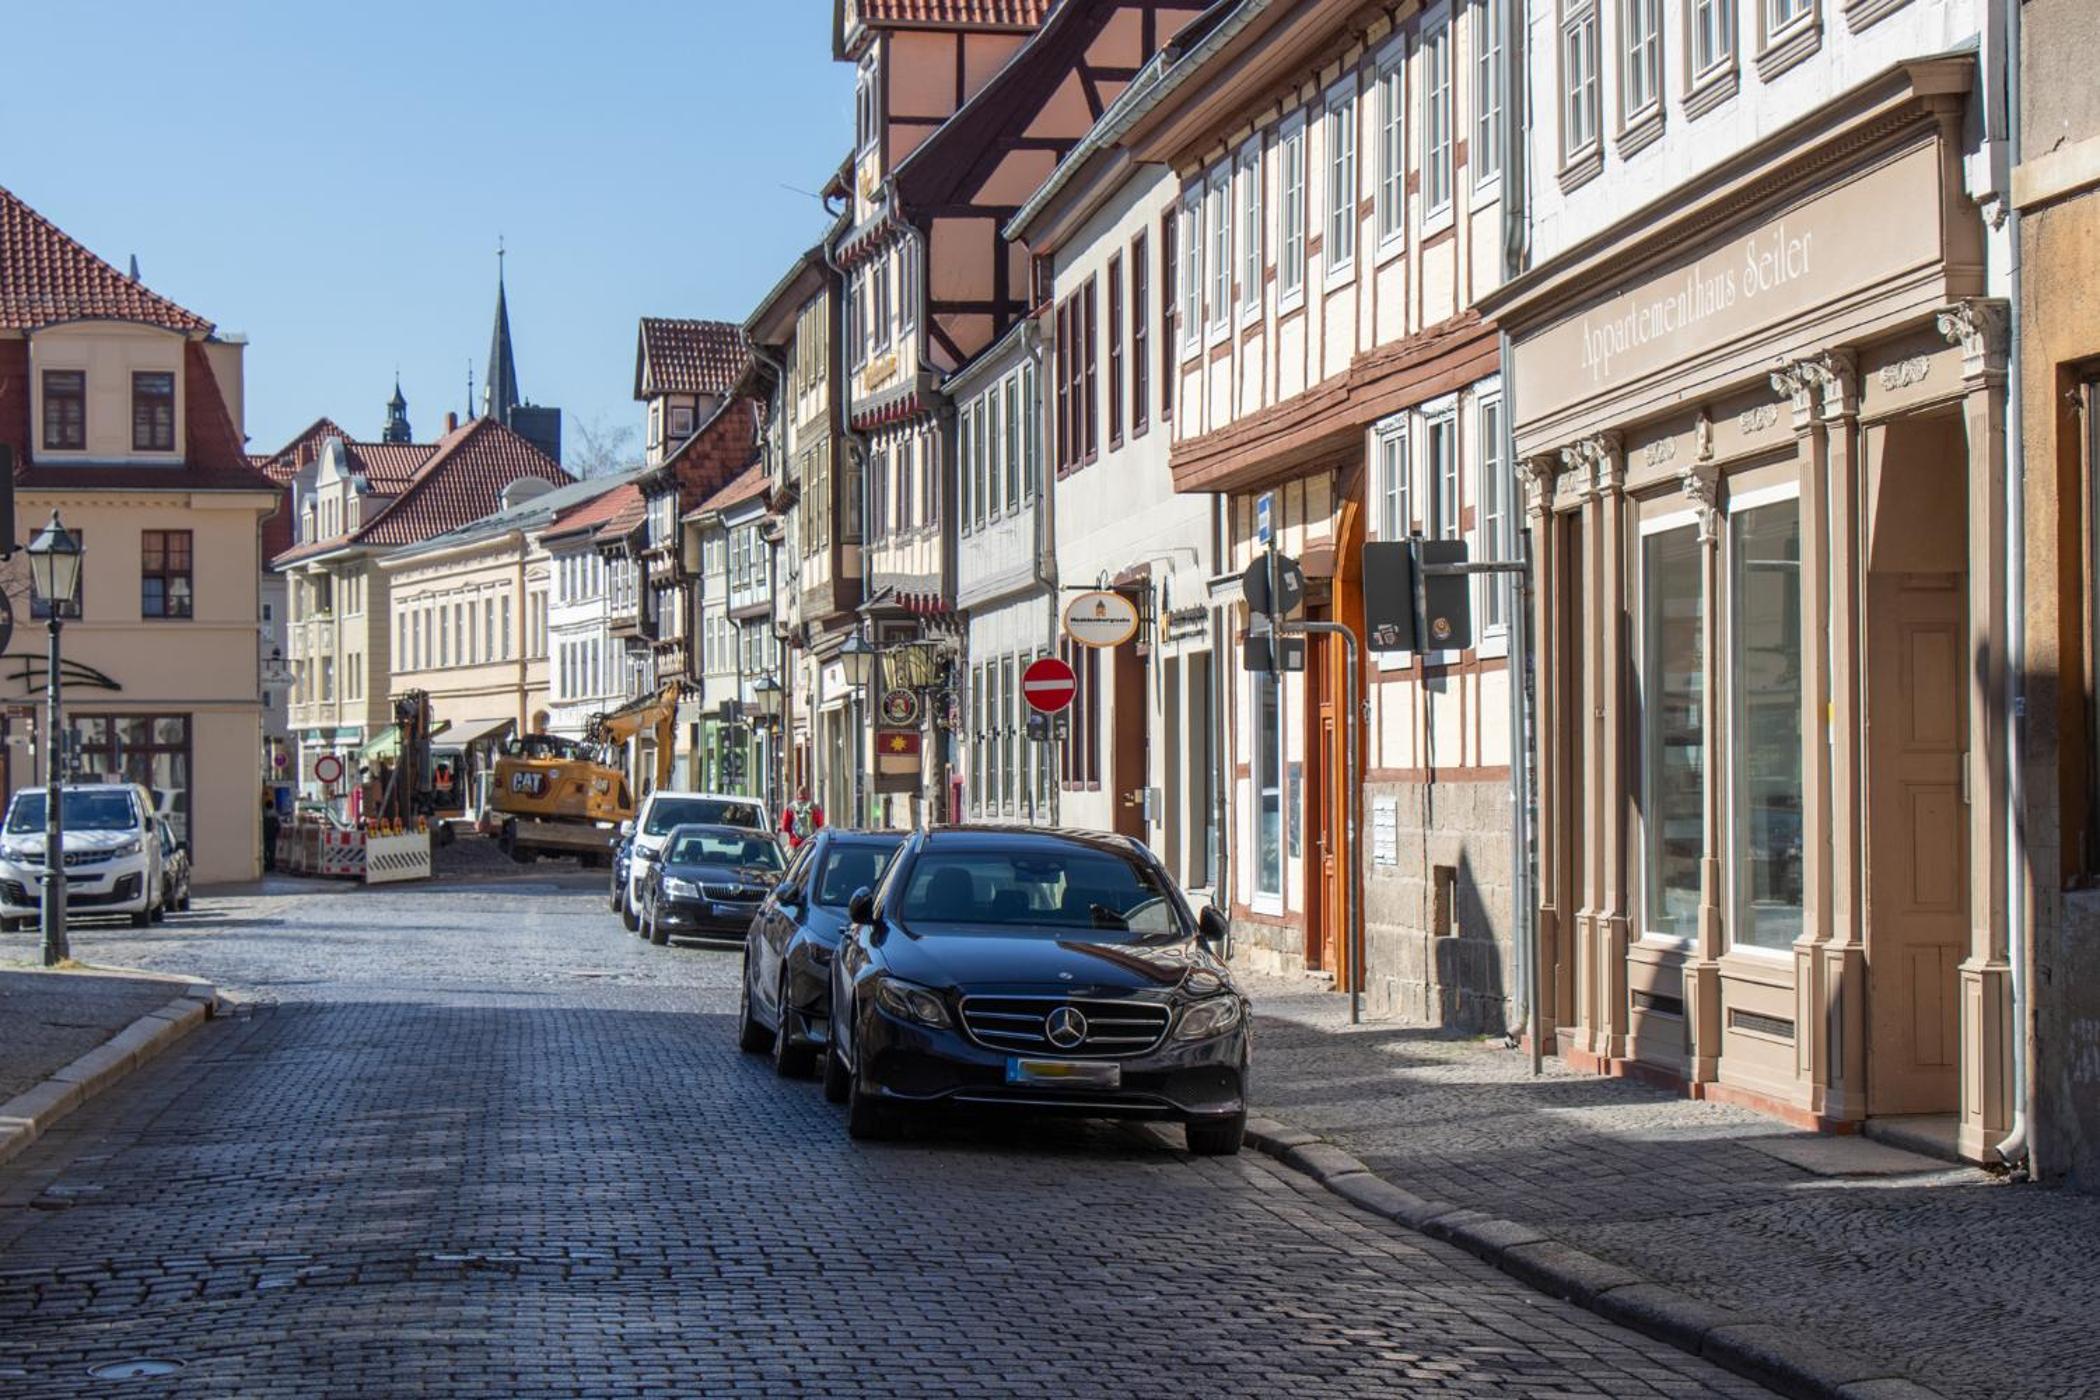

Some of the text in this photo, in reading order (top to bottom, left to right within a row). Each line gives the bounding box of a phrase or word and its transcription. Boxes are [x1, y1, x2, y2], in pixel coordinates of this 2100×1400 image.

[1582, 223, 1812, 380] Appartementhaus Seiler
[512, 771, 543, 793] CAT
